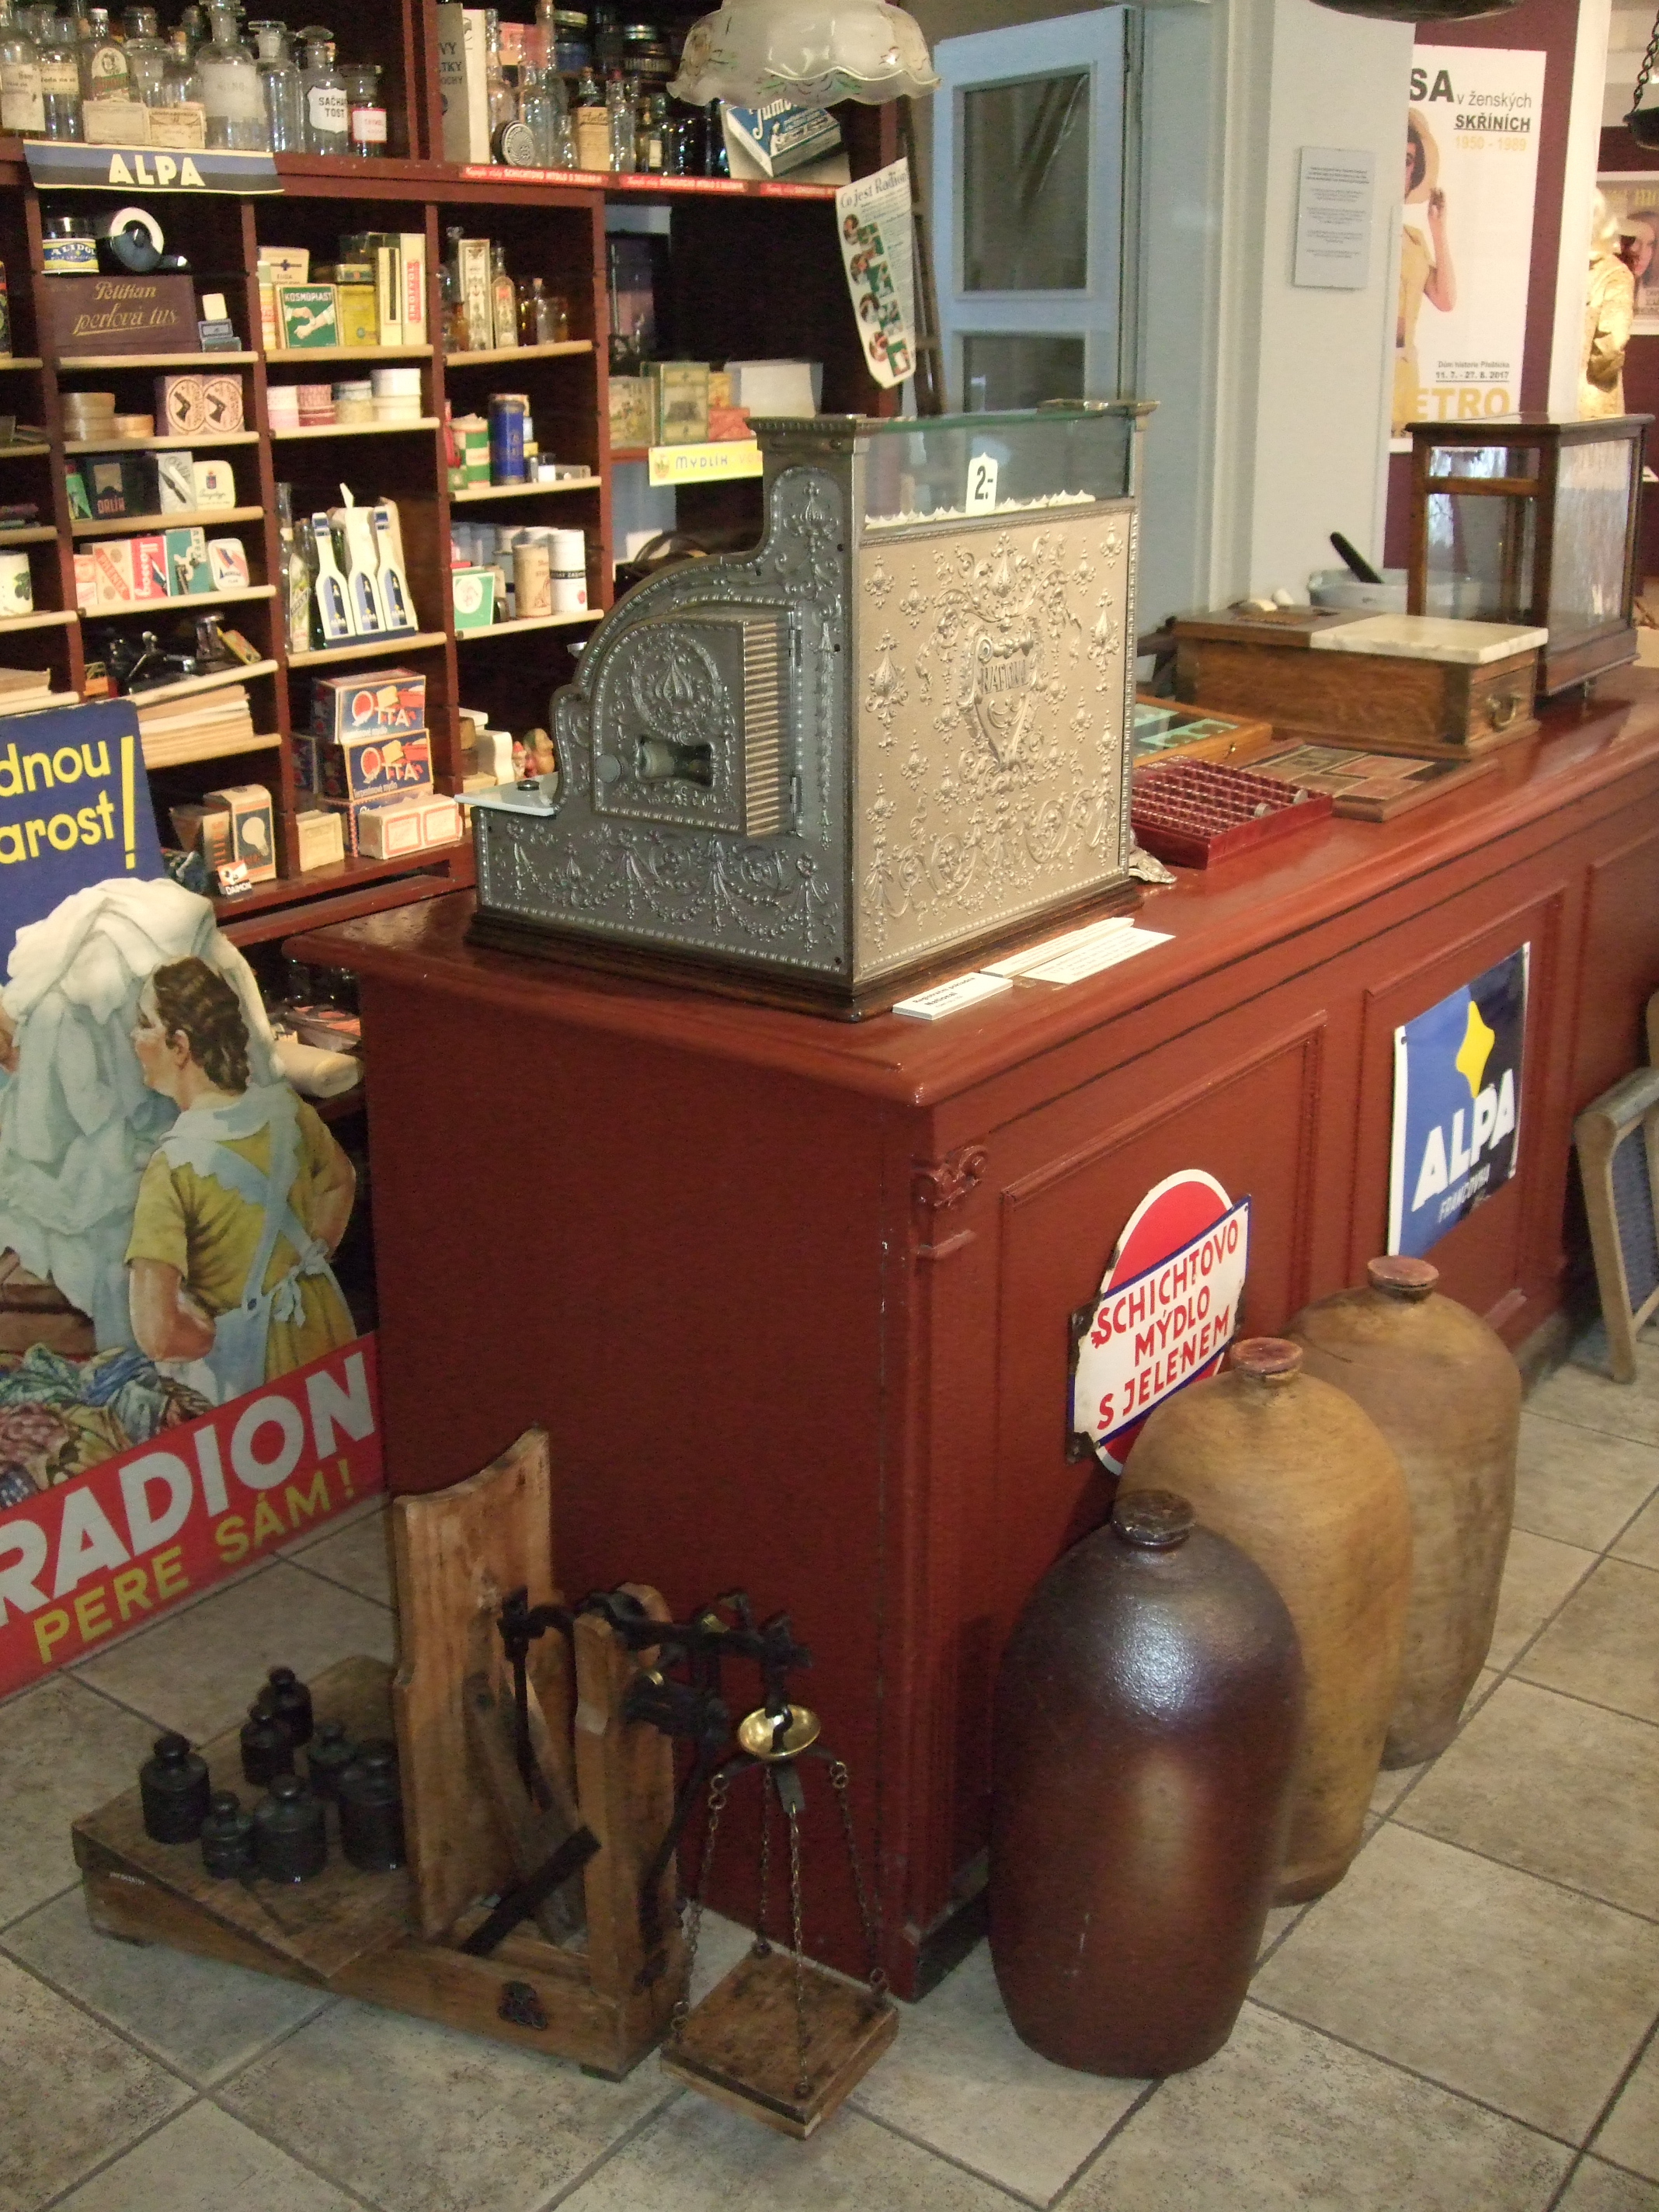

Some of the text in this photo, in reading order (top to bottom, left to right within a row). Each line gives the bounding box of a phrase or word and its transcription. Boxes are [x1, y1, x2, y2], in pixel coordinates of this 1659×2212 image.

[1455, 112, 1531, 130] SKŘÍNÍCH
[1456, 91, 1532, 111] v ženských
[109, 154, 206, 186] ALPA
[1456, 135, 1485, 150] 1950
[283, 292, 332, 302] KOSMOPLAST
[675, 455, 729, 470] MYDLÍK
[0, 740, 111, 797] dnou
[0, 790, 115, 864] arost
[1410, 1068, 1515, 1212] ALPA
[1090, 1219, 1239, 1349] SCHICHTOVO
[1135, 1285, 1210, 1367] MÝDLO
[1097, 1305, 1230, 1431] S JELENEM
[0, 1351, 375, 1627] RADION
[33, 1546, 190, 1664] PERE
